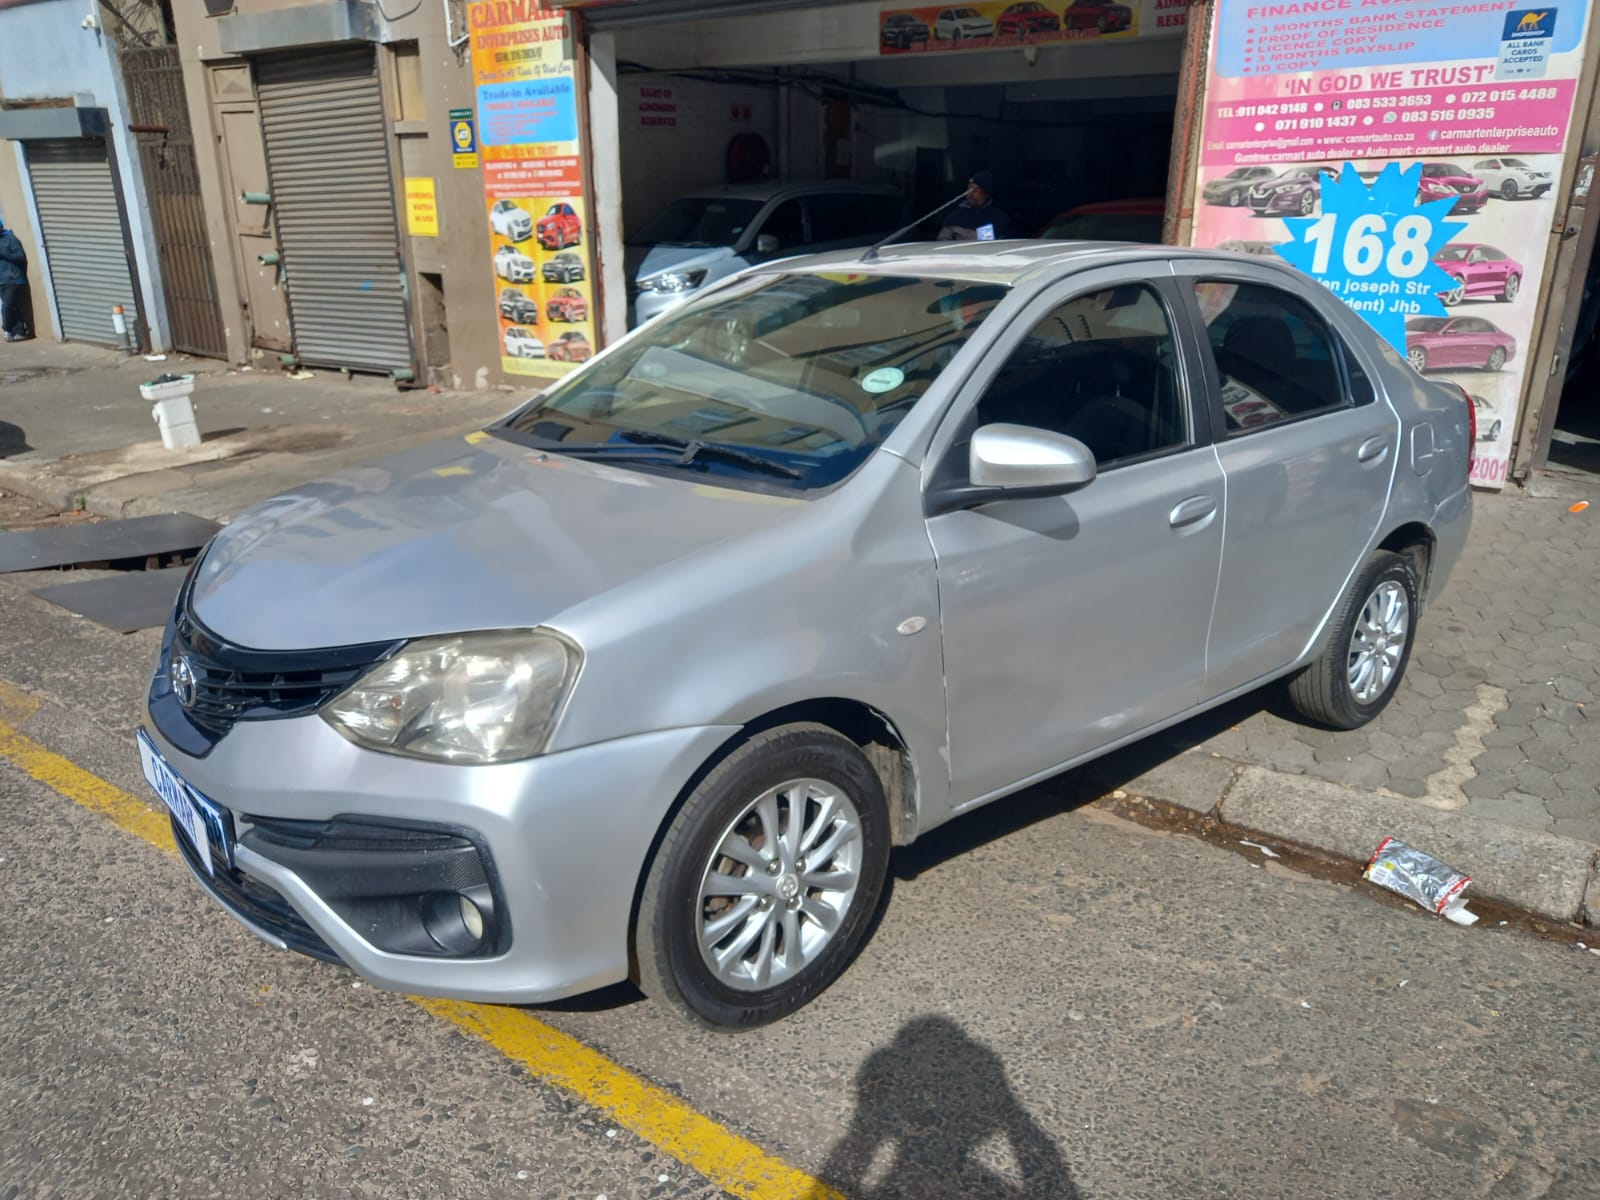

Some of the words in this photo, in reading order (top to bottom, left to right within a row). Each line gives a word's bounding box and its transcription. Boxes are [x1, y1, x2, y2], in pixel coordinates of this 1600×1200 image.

[1247, 0, 1352, 19] FINANCE
[1273, 18, 1344, 32] MONTHS
[1350, 12, 1397, 25] BANK
[1404, 1, 1517, 19] STATEMENT
[543, 24, 570, 42] AUTO
[1258, 32, 1313, 45] PROOF
[1318, 30, 1338, 39] OF
[1344, 19, 1445, 36] RESIDENCE
[1257, 40, 1329, 54] LICENCE
[1332, 35, 1378, 49] COPY
[1270, 49, 1340, 62] MONTHS
[1345, 41, 1415, 56] PAYSLIP
[1512, 48, 1538, 56] CARDS
[1256, 64, 1271, 73] ID
[1276, 60, 1320, 71] COPY
[1503, 56, 1544, 64] ACCEPTED
[1319, 74, 1363, 93] GOD
[1370, 69, 1403, 89] WE
[1410, 64, 1495, 87] TRUST'
[524, 84, 570, 97] Available
[1257, 104, 1279, 116] 042
[1280, 102, 1308, 115] 9148
[1347, 98, 1370, 110] 083
[1373, 96, 1397, 108] 533
[1398, 94, 1432, 107] 3653
[1461, 91, 1488, 104] 072
[1489, 89, 1515, 102] 015
[1518, 87, 1558, 100] 4488
[1275, 118, 1297, 131] 071
[1299, 117, 1324, 129] 910
[1326, 115, 1357, 127] 1437
[1401, 110, 1428, 123] 083
[1430, 109, 1454, 121] 516
[1457, 107, 1496, 120] 0935
[1440, 125, 1558, 140] carmartenterpriseauto
[1306, 149, 1325, 160] auto
[1327, 147, 1354, 159] dealer
[1365, 146, 1387, 157] Auto
[1415, 145, 1455, 155] carmart
[1455, 145, 1476, 154] auto
[1478, 143, 1510, 153] dealer
[1304, 213, 1433, 278] 168
[1343, 278, 1400, 296] joseph
[1405, 281, 1431, 295] Str
[1340, 297, 1385, 315] dent)
[1389, 299, 1421, 313] Jhb
